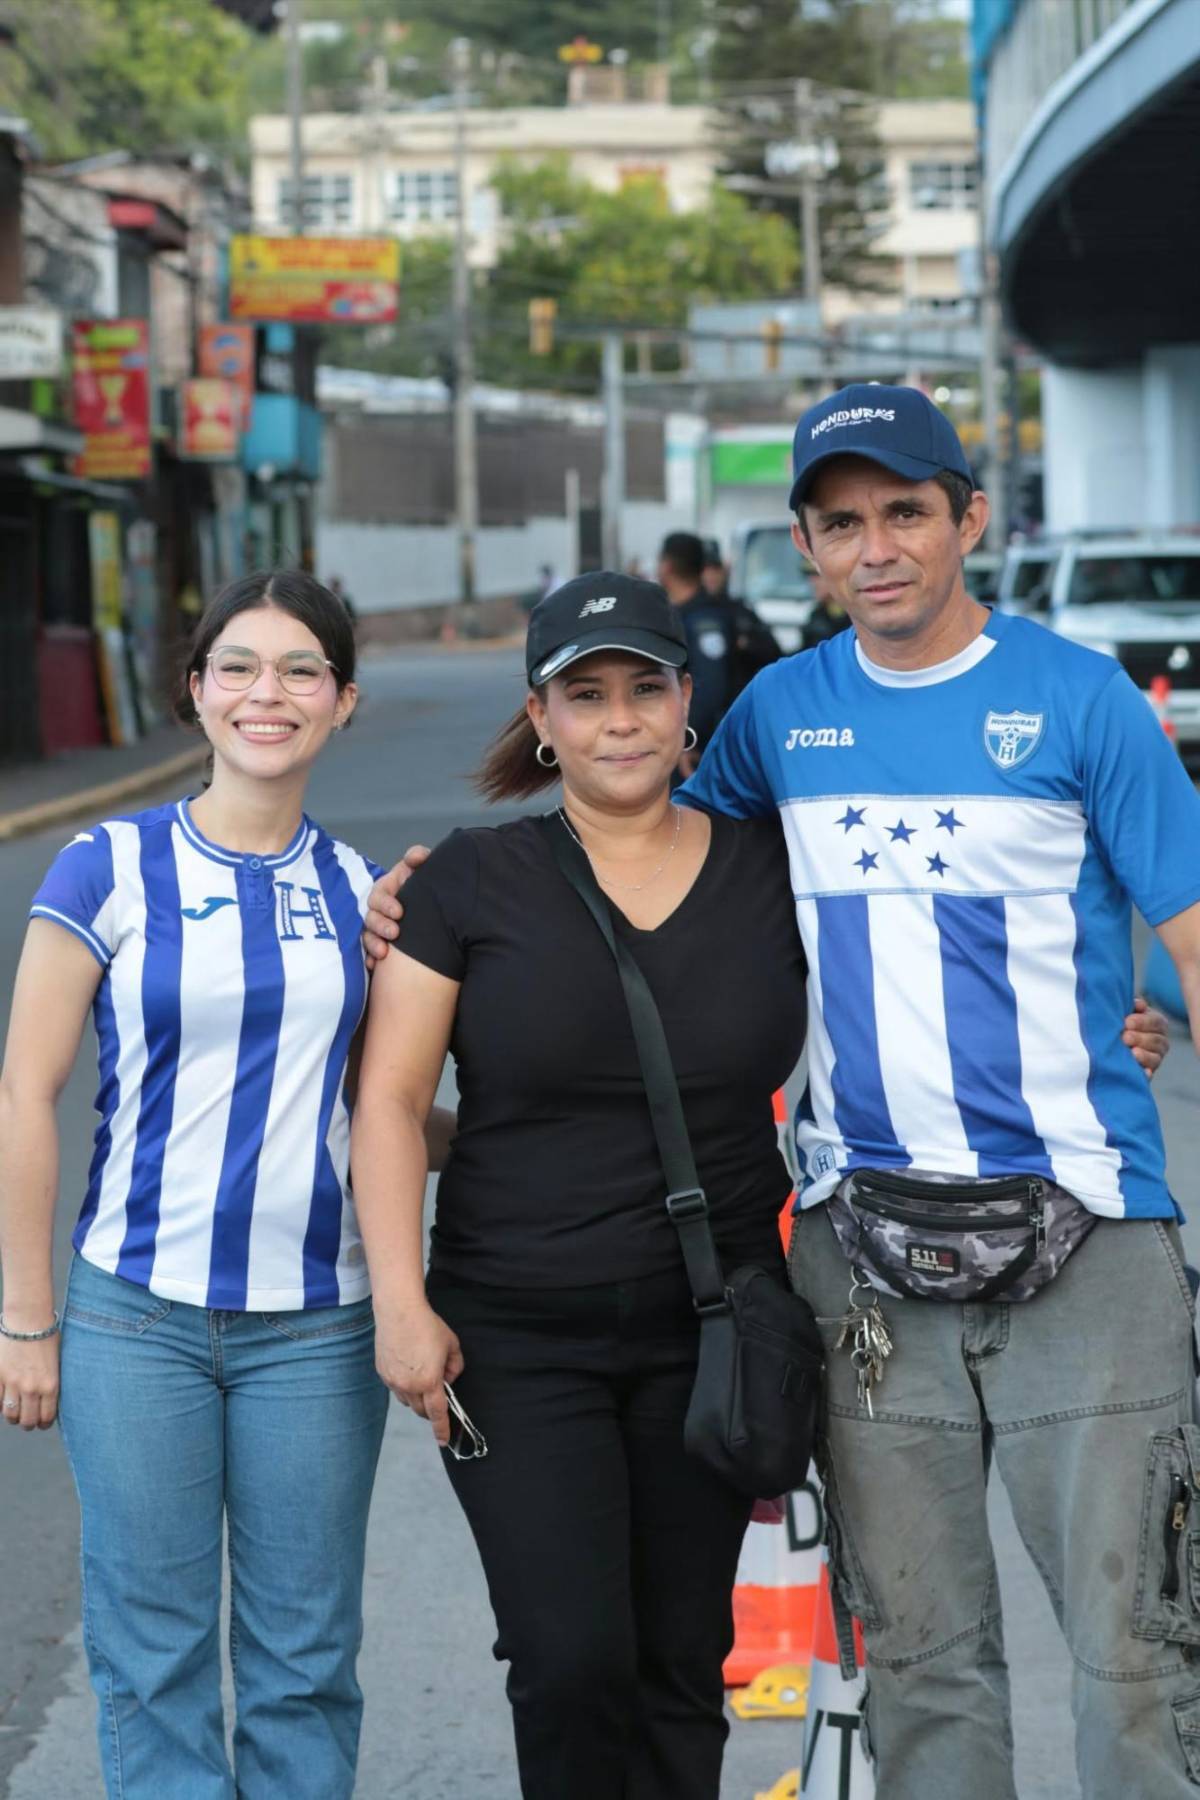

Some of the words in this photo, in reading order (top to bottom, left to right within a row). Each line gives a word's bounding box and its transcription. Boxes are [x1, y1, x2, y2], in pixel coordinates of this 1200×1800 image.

[811, 407, 896, 440] HONDURAS
[1000, 746, 1014, 761] H
[274, 881, 337, 941] H
[786, 1480, 823, 1552] D
